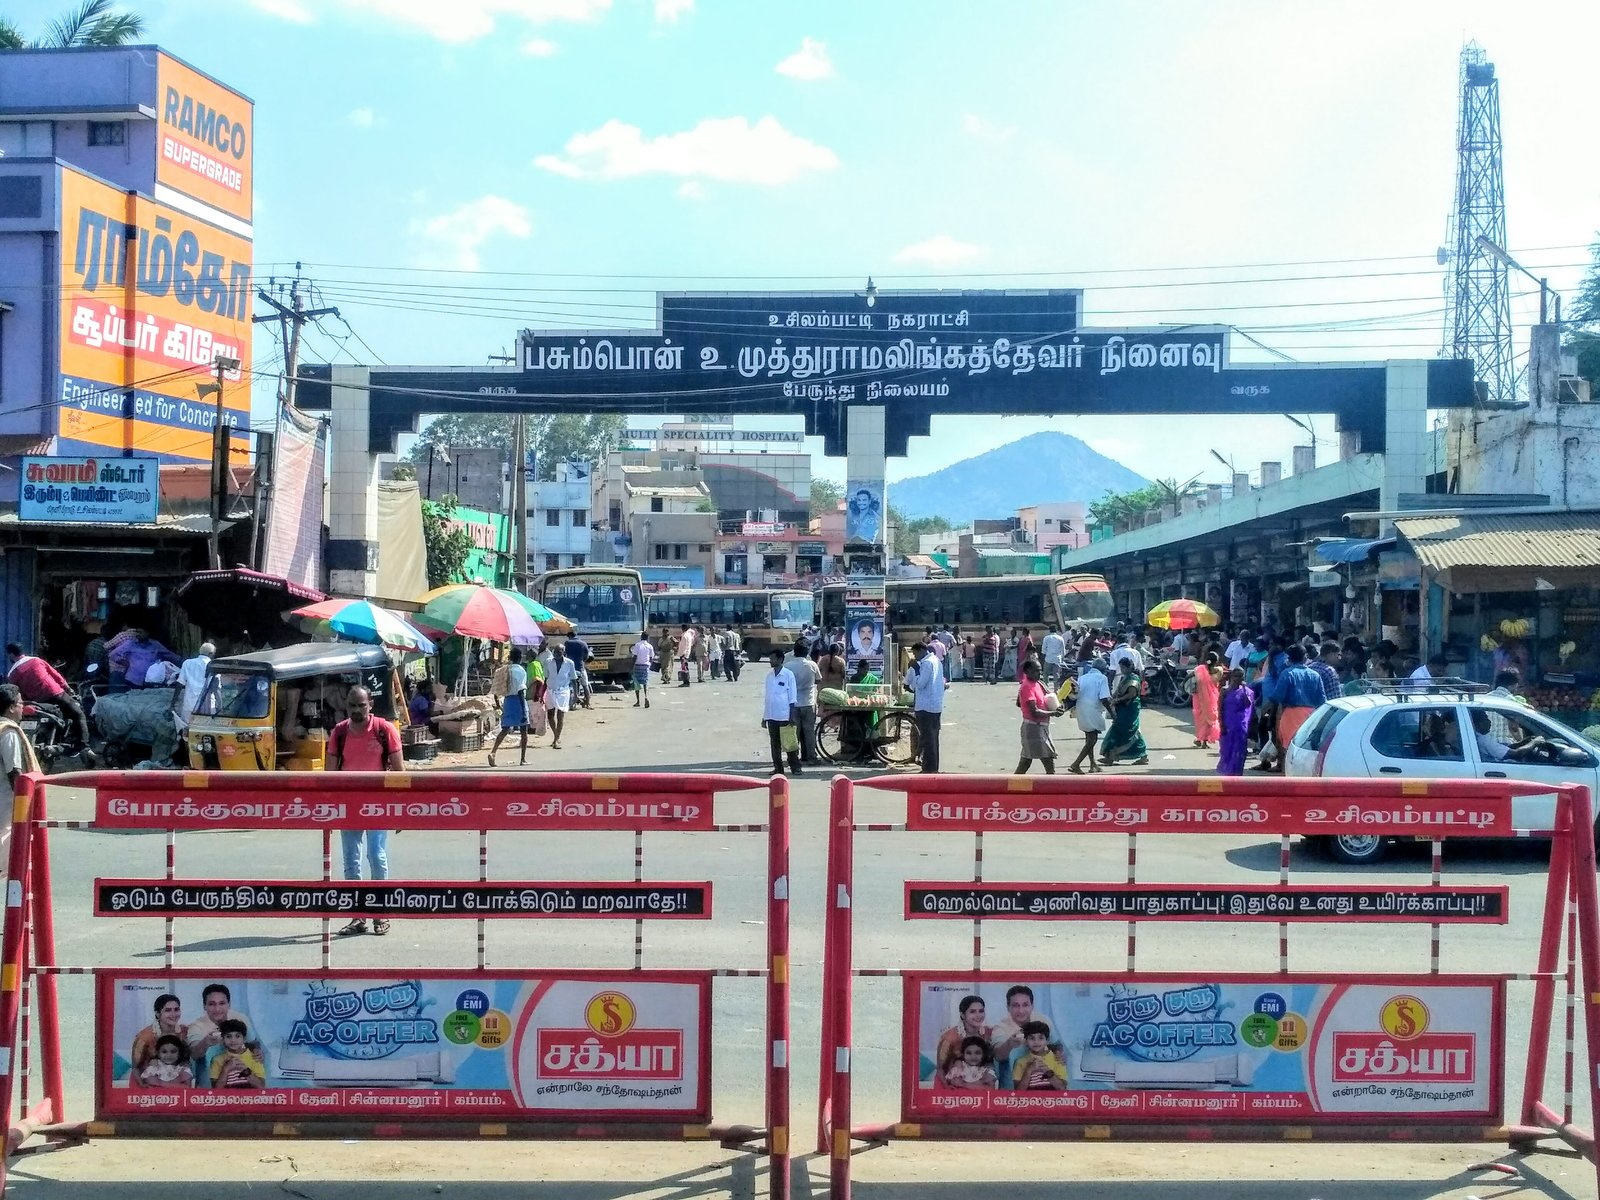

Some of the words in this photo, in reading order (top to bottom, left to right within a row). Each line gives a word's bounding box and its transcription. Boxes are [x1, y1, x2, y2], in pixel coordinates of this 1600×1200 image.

[164, 85, 246, 160] RAMCO
[163, 137, 242, 191] SUPERGRADE
[75, 206, 251, 322] ராம்கோ
[73, 305, 160, 352] சூப்பர்
[768, 310, 874, 330] உசிலம்பட்டி
[888, 309, 969, 331] நகராட்சி
[525, 337, 685, 371] பசும்பொன்
[1100, 334, 1222, 376] நினைவு
[783, 380, 855, 401] பேருந்து
[866, 376, 950, 399] நிலையம்
[155, 397, 176, 420] for
[618, 429, 657, 439] MULTI
[663, 430, 735, 440] SPECIALITY
[742, 431, 800, 441] HOSPITAL
[26, 458, 98, 484] சுவாமி
[100, 463, 145, 483] ஸ்டோர்
[107, 797, 347, 820] போக்குவரத்து
[359, 797, 470, 818] காவல்
[506, 797, 700, 822] உசிலம்பட்டி
[921, 801, 1148, 826] போக்குவரத்து
[1160, 804, 1268, 823] காவல்
[1304, 804, 1496, 828] உசிலம்பட்டி
[111, 887, 165, 910] ஓடும்
[171, 886, 276, 910] பேருந்தில்
[280, 889, 360, 910] ஏறாதே!
[365, 888, 457, 911] உயிரைப்
[463, 889, 576, 913] போக்கிடும்
[582, 892, 688, 913] மறவாதே!!
[922, 892, 1024, 914] ஹெல்மெட்
[1029, 892, 1116, 915] அணிவது
[1122, 891, 1226, 915] பாதுகாப்பு!
[1229, 894, 1294, 916] இதுவே
[1299, 895, 1352, 915] உனது
[1359, 892, 1486, 916] உயிர்க்காப்பு!!
[463, 1000, 482, 1009] EMI
[1261, 1003, 1280, 1012] EMI
[290, 1021, 334, 1044] AC
[335, 1020, 438, 1043] OFFER
[481, 1035, 502, 1044] Gifts
[1092, 1023, 1135, 1047] AC
[1136, 1023, 1236, 1046] OFFER
[1278, 1038, 1299, 1047] Gifts
[543, 1037, 677, 1072] சத்யா
[1339, 1041, 1469, 1076] சத்யா
[127, 1094, 180, 1107] மதுரை
[299, 1092, 339, 1107] தேனி
[349, 1091, 440, 1108] சின்னமனூர்
[536, 1081, 593, 1096] என்றாலே
[596, 1083, 684, 1100] சந்தோஷம்தான்
[931, 1094, 984, 1108] மதுரை
[993, 1092, 1089, 1109] வத்தலகுண்டு
[1100, 1094, 1139, 1109] தேனி
[1149, 1093, 1240, 1110] சின்னமனூர்
[1332, 1084, 1387, 1099] என்றாலே
[1390, 1087, 1475, 1102] சந்தோஷம்தான்
